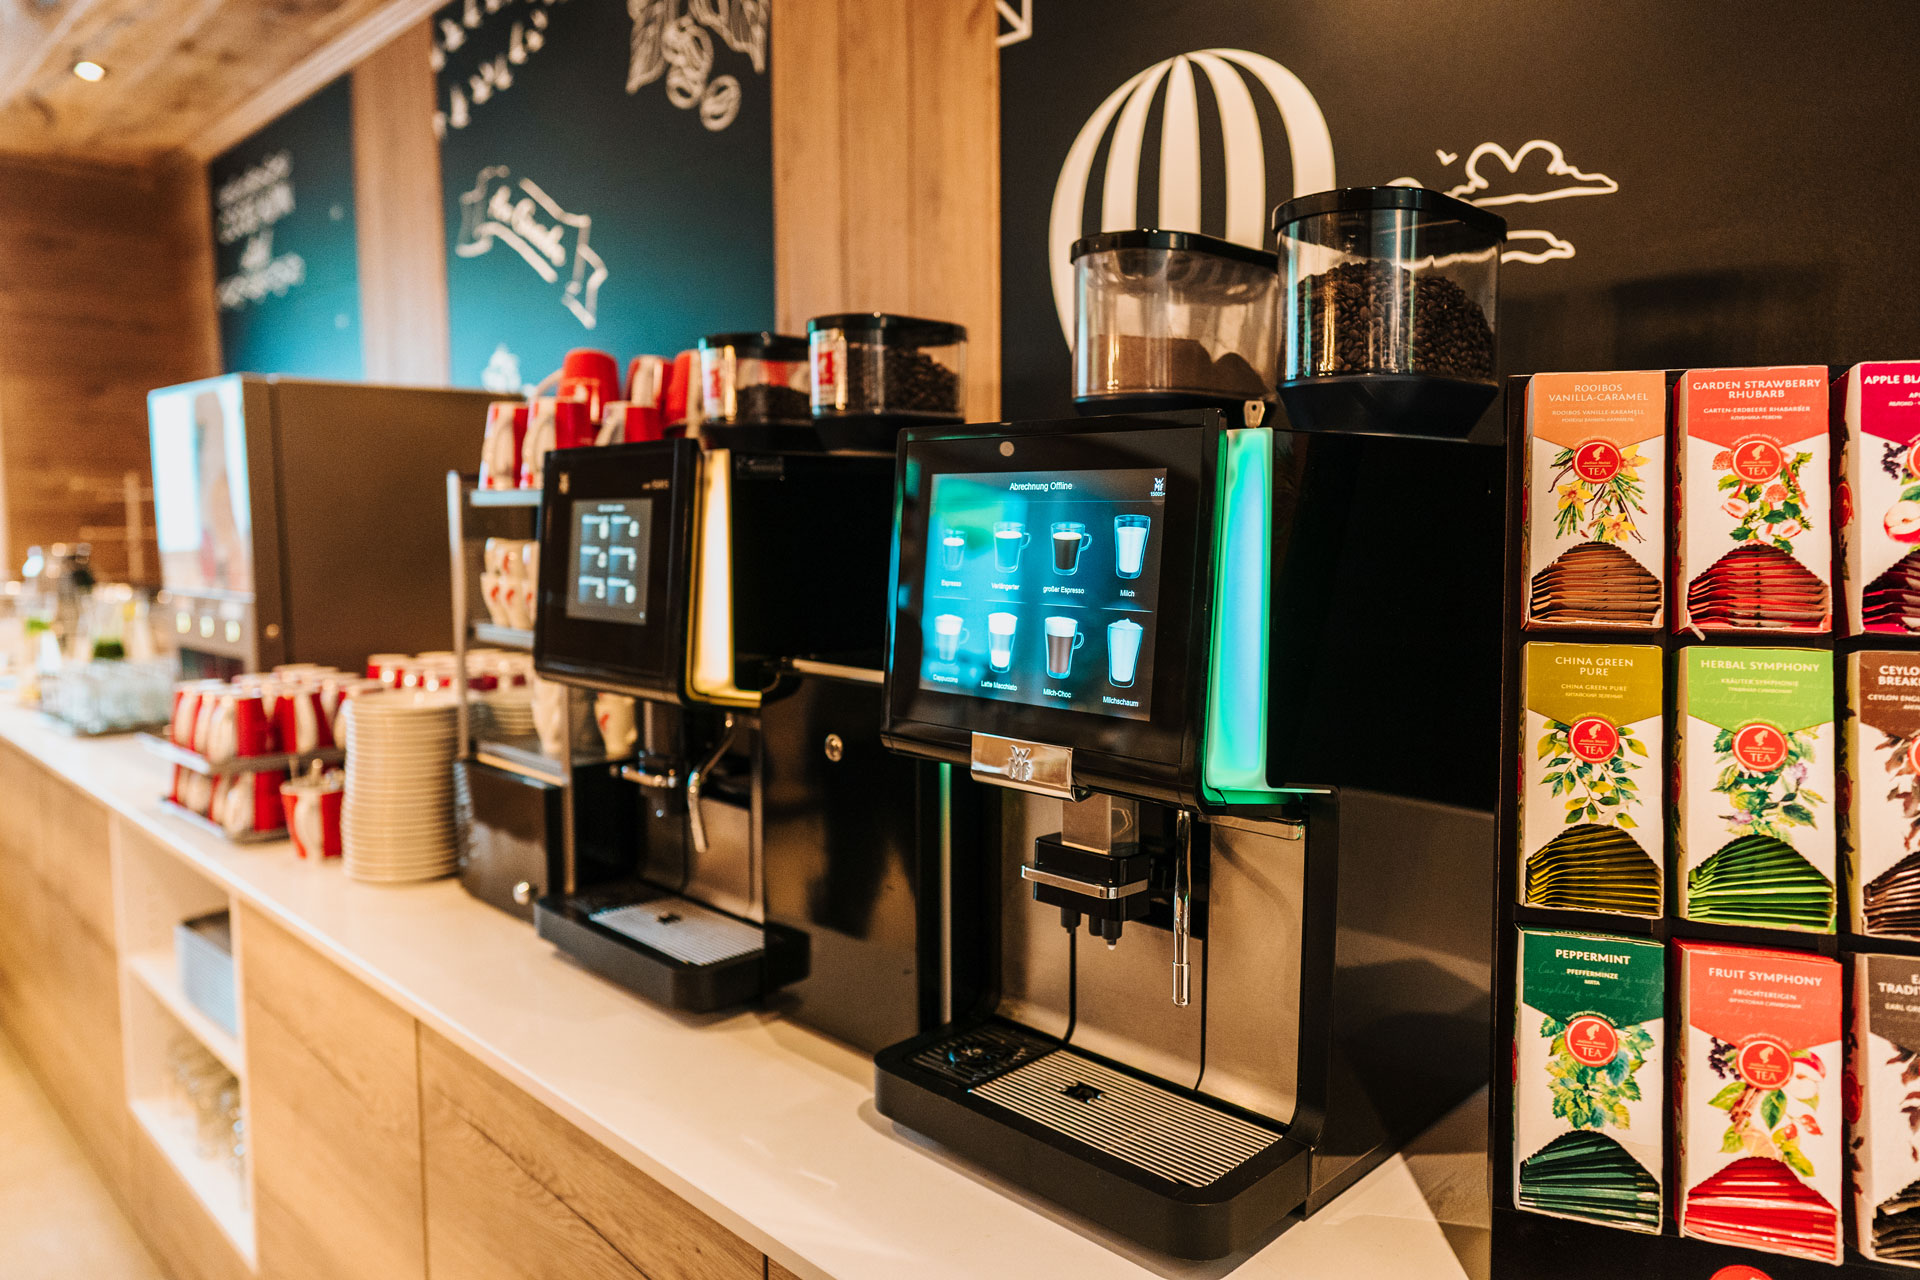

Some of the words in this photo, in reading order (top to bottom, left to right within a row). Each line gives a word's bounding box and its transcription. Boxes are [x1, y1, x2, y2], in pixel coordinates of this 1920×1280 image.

[1693, 381, 1741, 391] GARDEN
[1745, 379, 1821, 389] STRAWBERRY
[1864, 375, 1900, 385] APPLE
[1575, 384, 1623, 392] ROOIBOS
[1549, 393, 1649, 402] VANILLA-CARAMEL
[1729, 390, 1785, 399] RHUBARB
[1588, 467, 1607, 476] TEA
[1748, 467, 1768, 476] TEA
[1009, 482, 1048, 492] Abrechnung
[1050, 482, 1073, 490] Offline
[1043, 586, 1060, 594] großer
[1061, 587, 1085, 595] Espresso
[1555, 657, 1593, 666] CHINA
[1596, 658, 1633, 667] GREEN
[1701, 660, 1746, 670] HERBAL
[1750, 661, 1820, 672] SYMPHONY
[1580, 667, 1608, 676] PURE
[981, 680, 993, 688] Latte
[994, 682, 1017, 691] Macchiato
[1043, 688, 1072, 698] Milch-Choc
[1103, 696, 1139, 707] Milchschaum
[1584, 746, 1604, 755] TEA
[1750, 753, 1771, 762] TEA
[1555, 949, 1631, 965] PEPPERMINT
[1566, 968, 1619, 980] PFEFFERMINZE
[1708, 967, 1746, 979] FRUIT
[1749, 971, 1823, 986] SYMPHONY
[1733, 989, 1797, 1001] FRÜCHTEREIGEN
[1581, 1047, 1602, 1058] TEA
[1755, 1071, 1777, 1082] TEA
